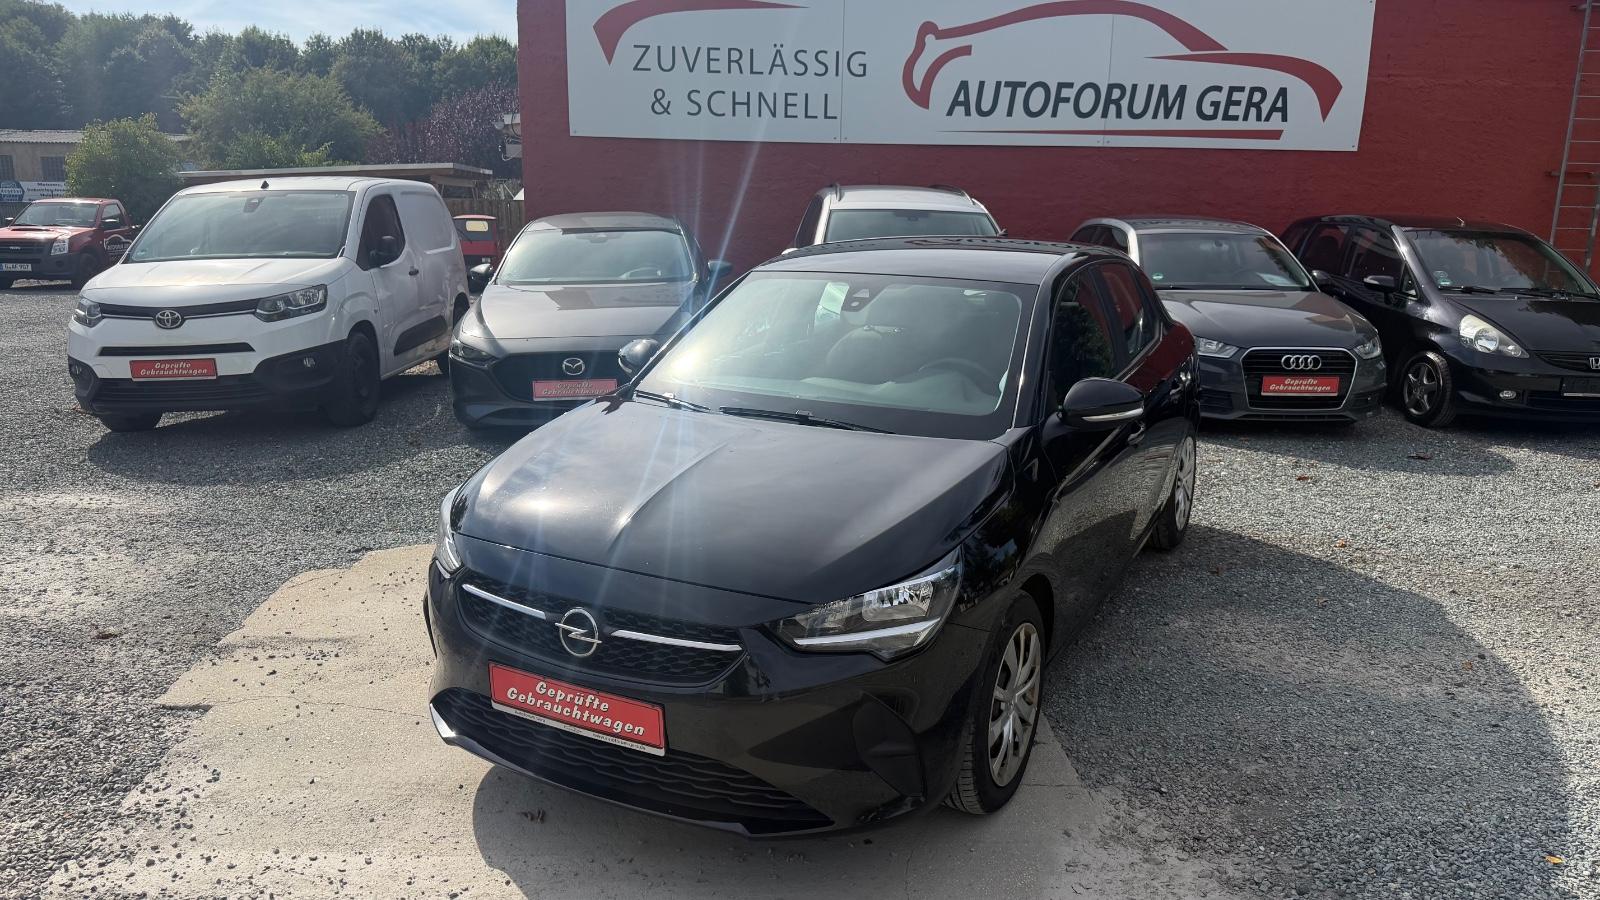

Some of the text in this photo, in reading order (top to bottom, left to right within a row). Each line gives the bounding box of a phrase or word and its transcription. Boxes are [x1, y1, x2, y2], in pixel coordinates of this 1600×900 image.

[632, 43, 867, 78] ZUVERLÄSSIG
[650, 88, 838, 120] & SCHNELL
[945, 79, 1289, 123] AUTOFORUM GERA
[140, 367, 208, 376] Gebrauchtwagen
[154, 361, 191, 370] Geprüfte
[1269, 384, 1331, 392] Gebrauchtwagen
[1284, 378, 1318, 386] Geprüfte
[506, 687, 645, 736] Gebrauchtwagen
[535, 681, 609, 712] Geprüfte
